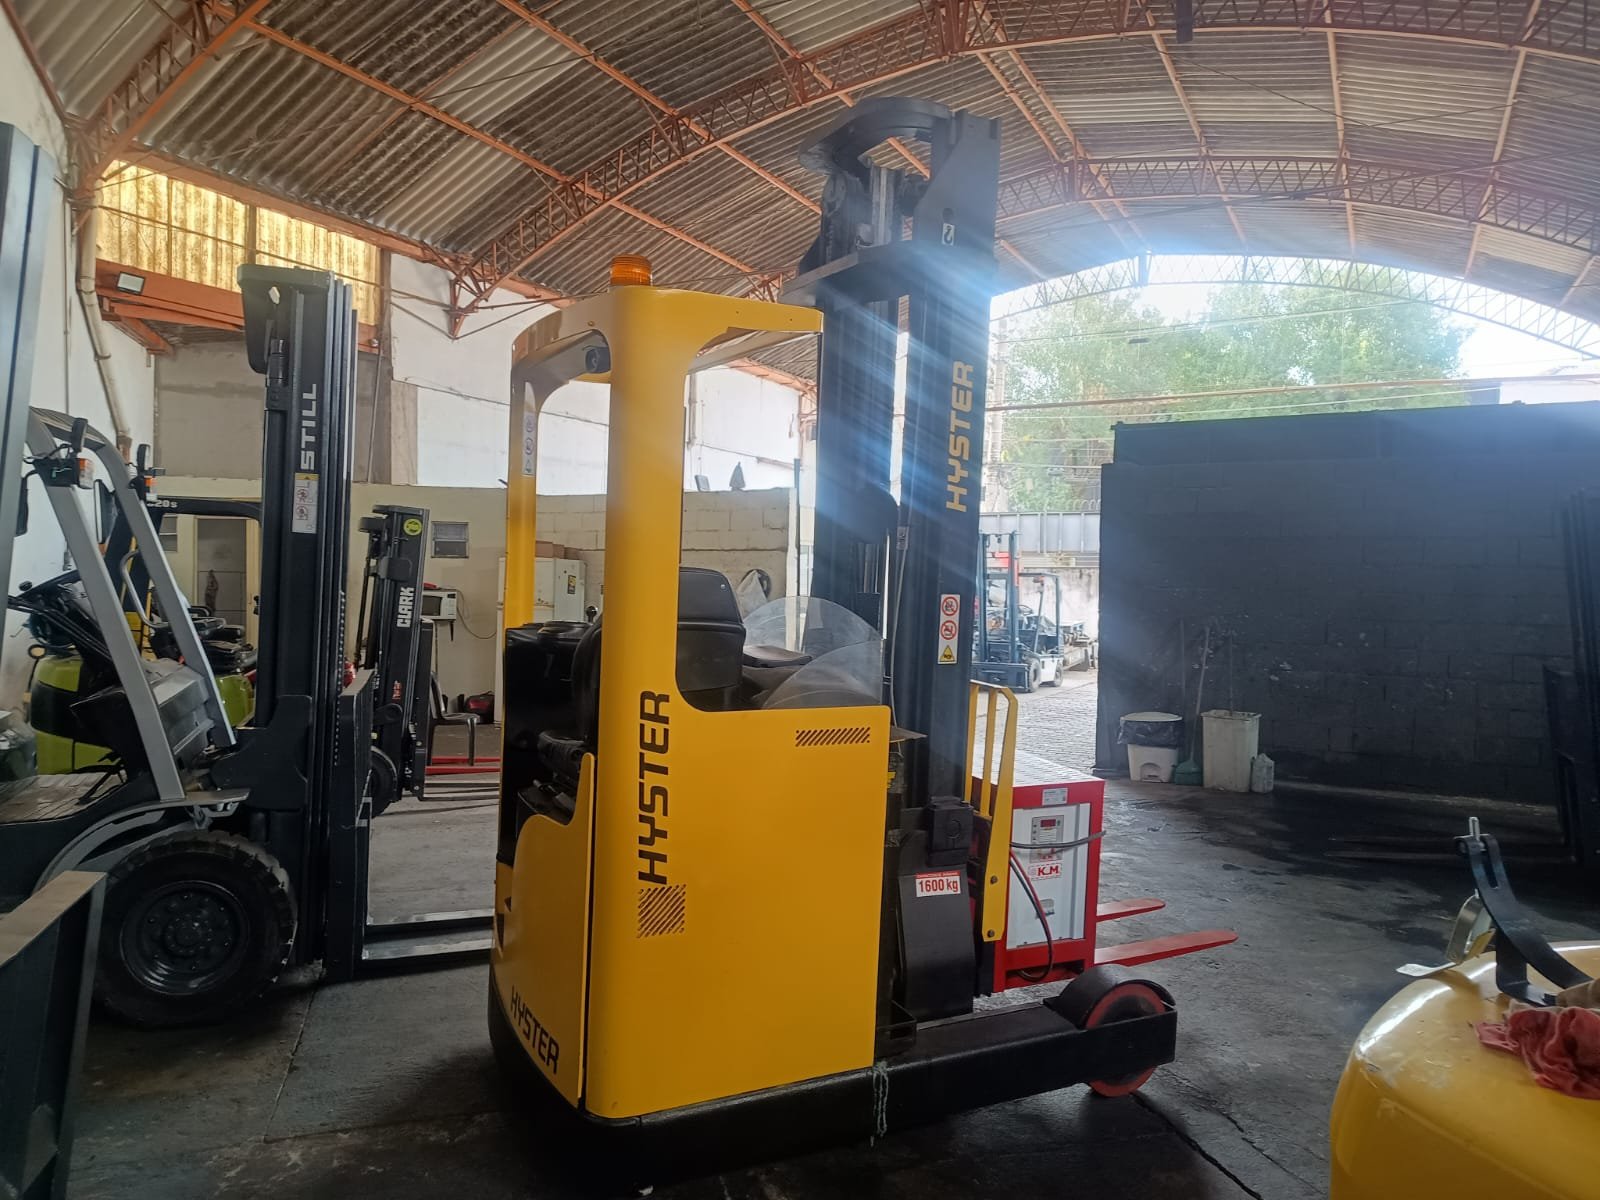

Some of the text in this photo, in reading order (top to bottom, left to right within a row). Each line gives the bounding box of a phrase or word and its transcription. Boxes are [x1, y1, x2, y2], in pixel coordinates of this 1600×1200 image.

[301, 383, 317, 470] STILL
[945, 360, 974, 513] HYSTER
[396, 587, 415, 628] CLARK
[638, 690, 670, 885] HYSTER
[919, 878, 959, 893] 1600 kg
[510, 984, 560, 1075] HYSTER
